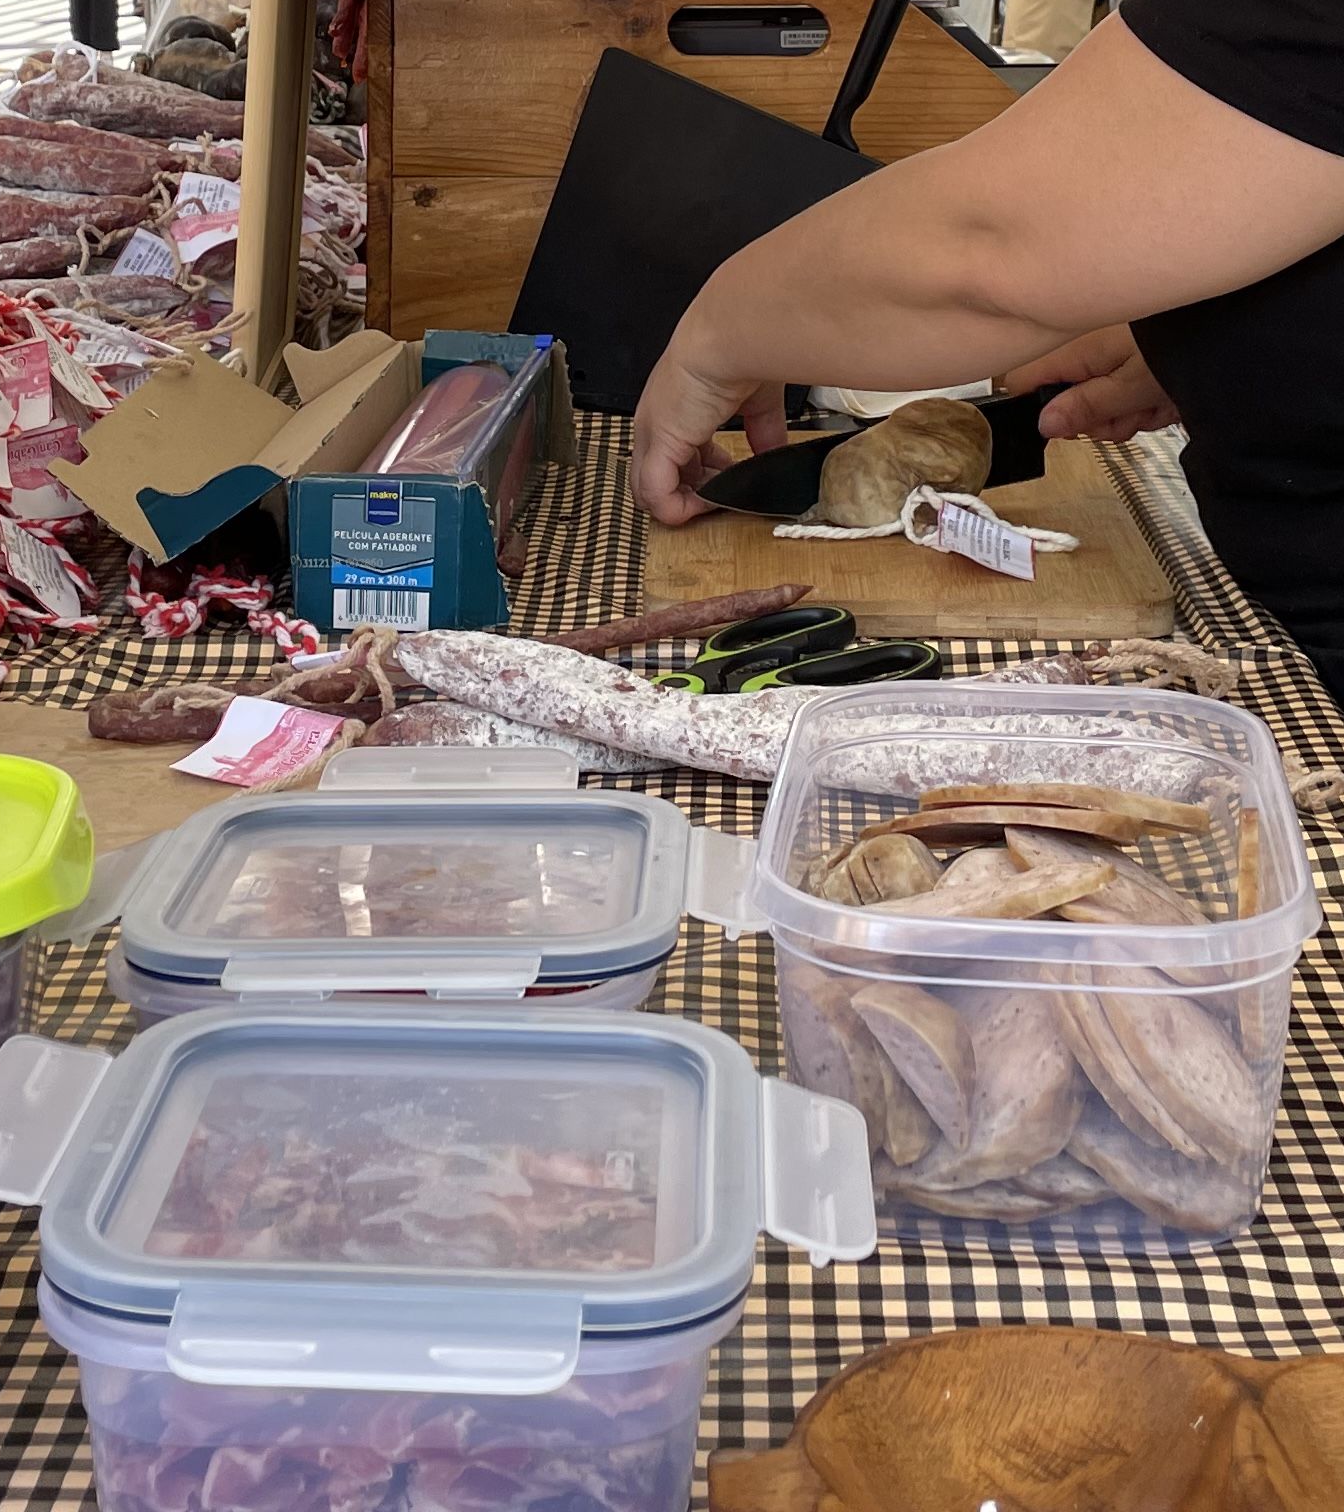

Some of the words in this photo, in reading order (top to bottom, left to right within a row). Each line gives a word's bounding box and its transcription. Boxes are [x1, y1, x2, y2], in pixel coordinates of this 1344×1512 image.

[37, 438, 62, 458] Can
[369, 490, 399, 501] makro
[333, 528, 380, 541] PELÍCULA
[382, 531, 433, 544] ADERENTE
[348, 541, 369, 551] COM
[371, 541, 417, 553] FATIADOR
[344, 573, 358, 584] 29
[359, 575, 376, 585] cm
[377, 576, 384, 585] x
[386, 575, 406, 586] 300
[407, 577, 418, 586] m
